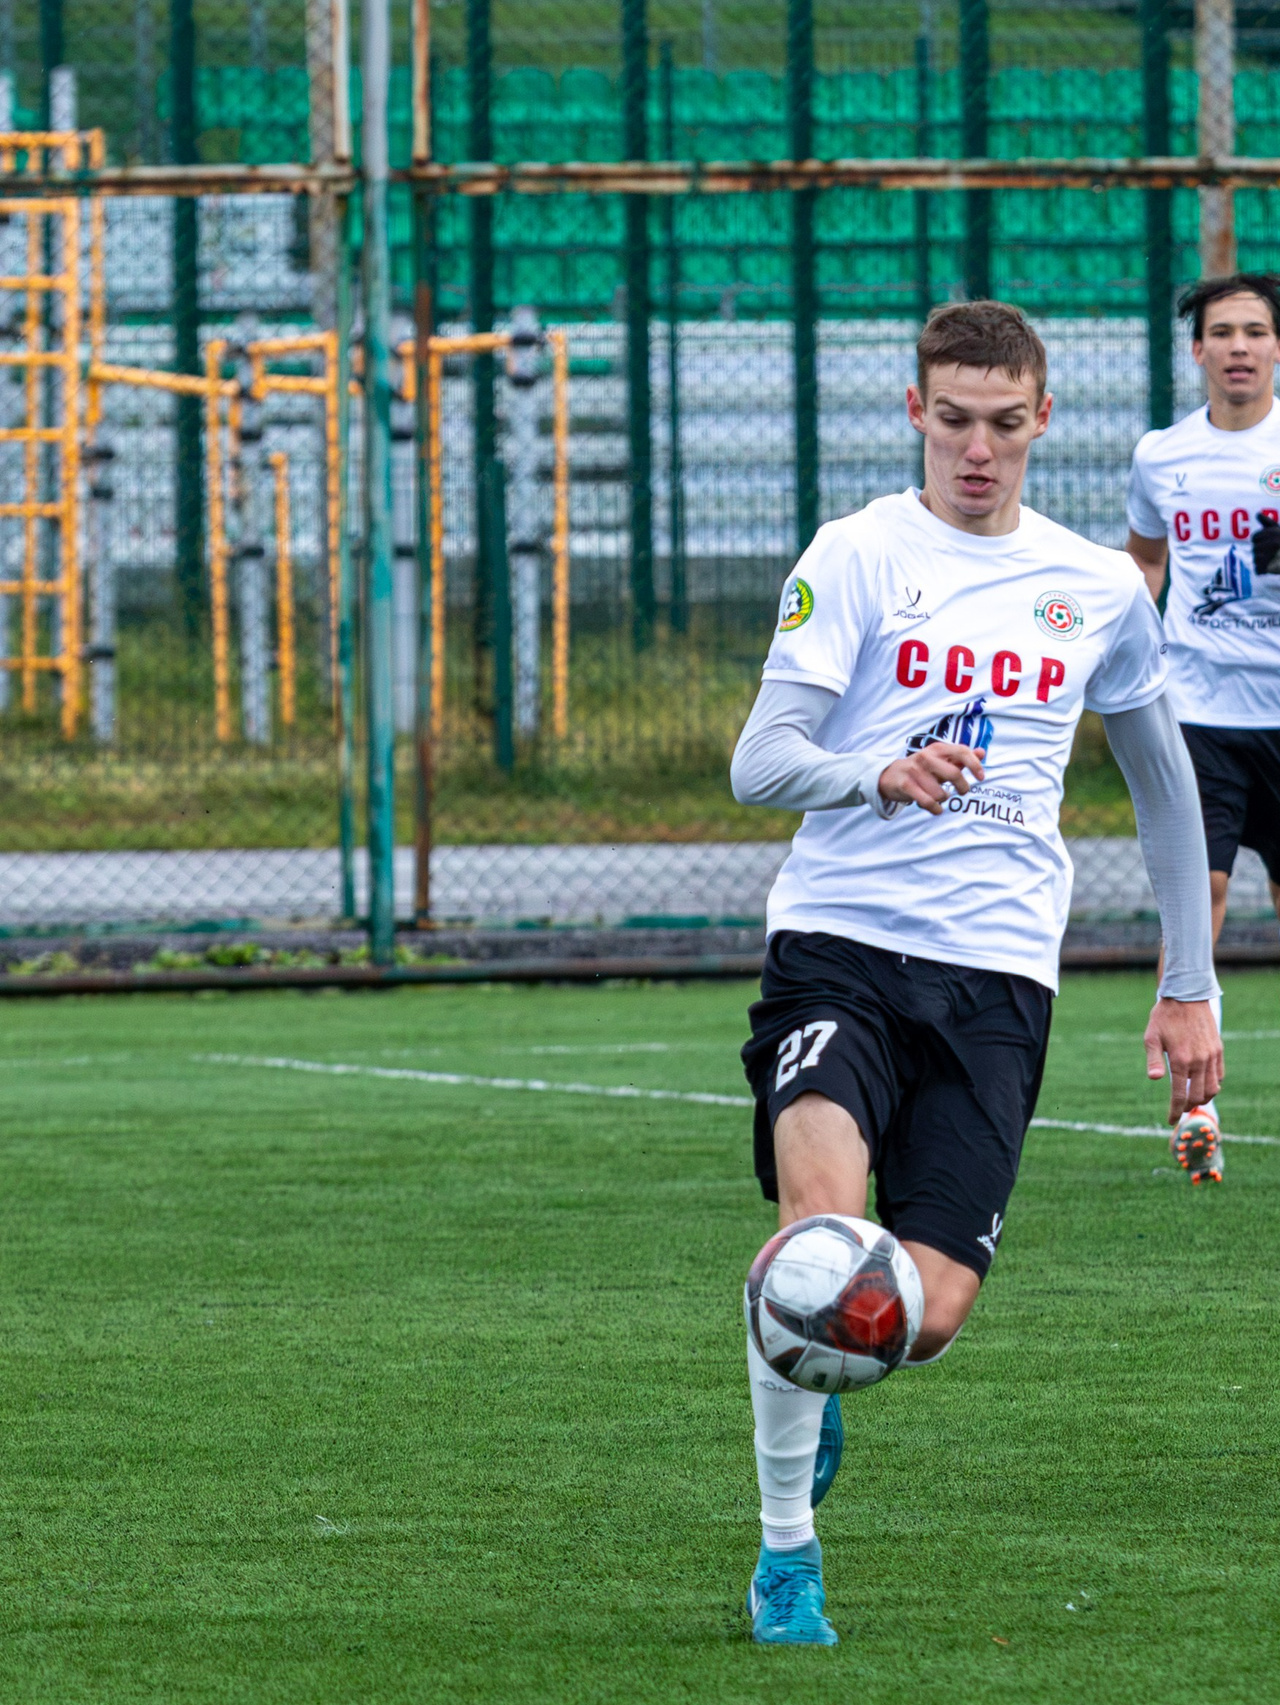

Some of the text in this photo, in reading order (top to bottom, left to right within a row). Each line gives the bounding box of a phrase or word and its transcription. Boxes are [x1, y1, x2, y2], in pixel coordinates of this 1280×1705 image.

[896, 639, 1065, 703] СССР
[967, 785, 1022, 804] ОМПАНИЙ
[775, 1020, 838, 1092] 27
